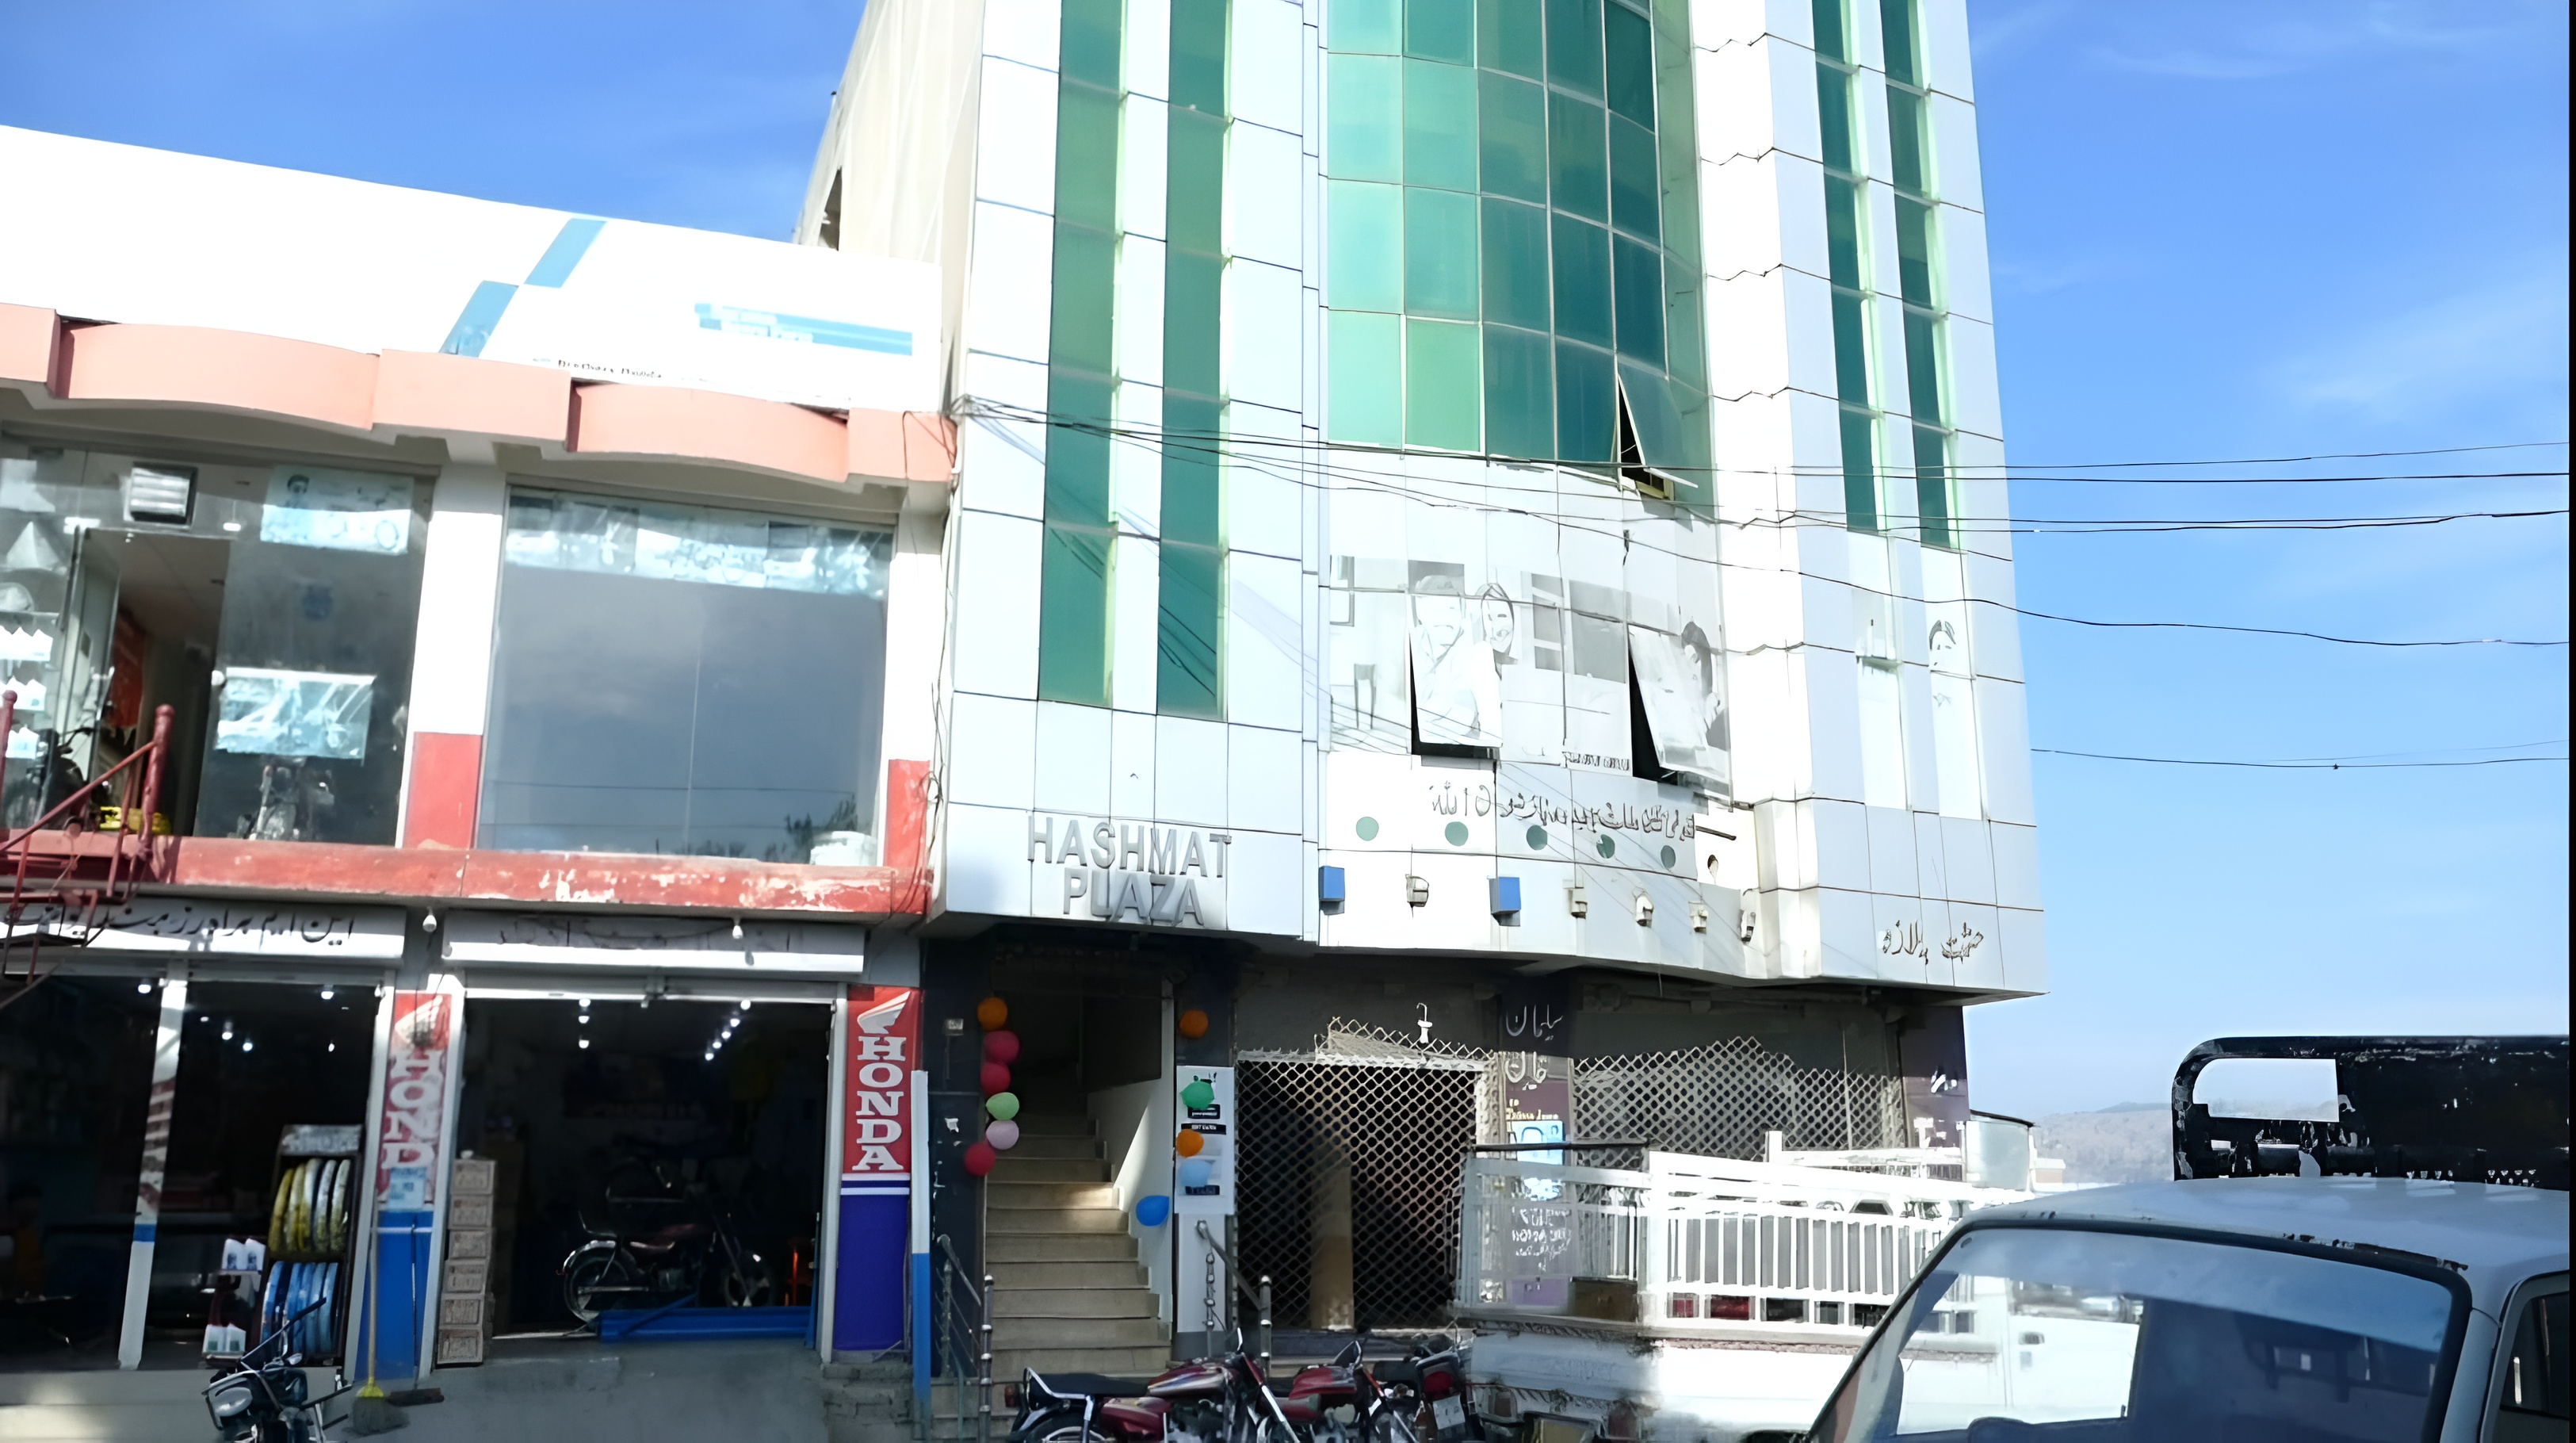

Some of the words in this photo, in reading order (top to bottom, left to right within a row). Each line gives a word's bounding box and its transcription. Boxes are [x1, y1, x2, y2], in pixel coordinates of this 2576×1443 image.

[1027, 815, 1233, 878] HASHMAT
[1063, 867, 1204, 927] PLAZA
[851, 1035, 907, 1171] HONDA
